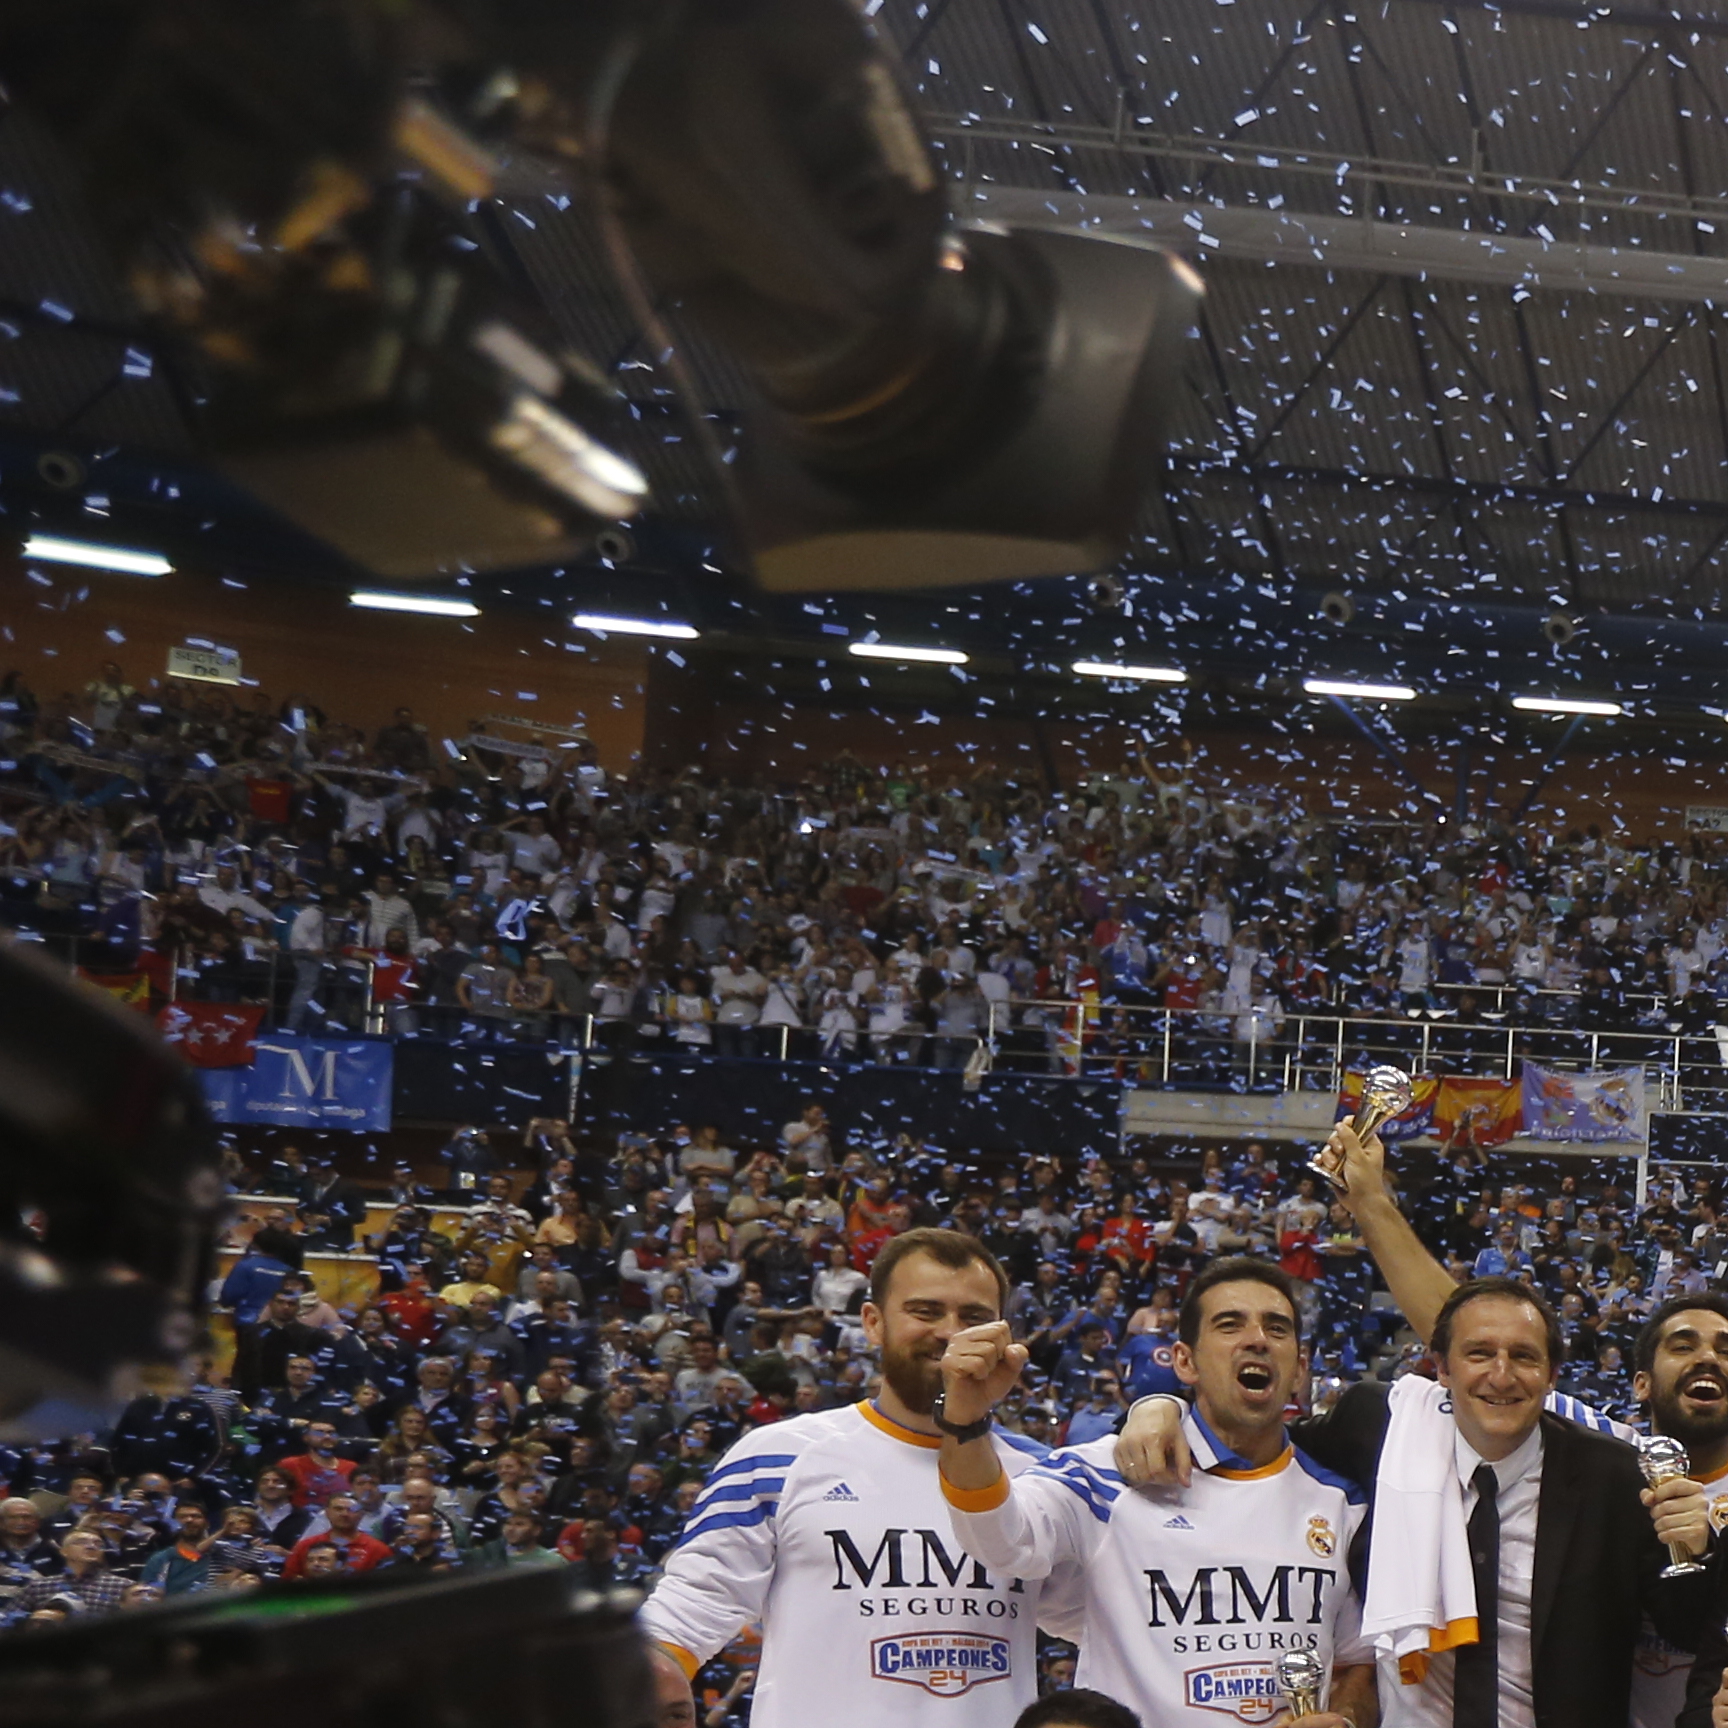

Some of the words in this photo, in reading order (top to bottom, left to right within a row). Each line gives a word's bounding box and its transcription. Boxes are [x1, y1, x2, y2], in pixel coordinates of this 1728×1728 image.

[823, 1494, 860, 1502] adidas
[1144, 1565, 1336, 1627] MMT
[860, 1598, 1018, 1618] SEGUROS
[1174, 1632, 1319, 1653] SEGUROS
[879, 1642, 1008, 1673] CAMPEONES
[929, 1670, 967, 1686] 24
[1193, 1673, 1281, 1703] CAMPEO
[1239, 1699, 1273, 1714] 24
